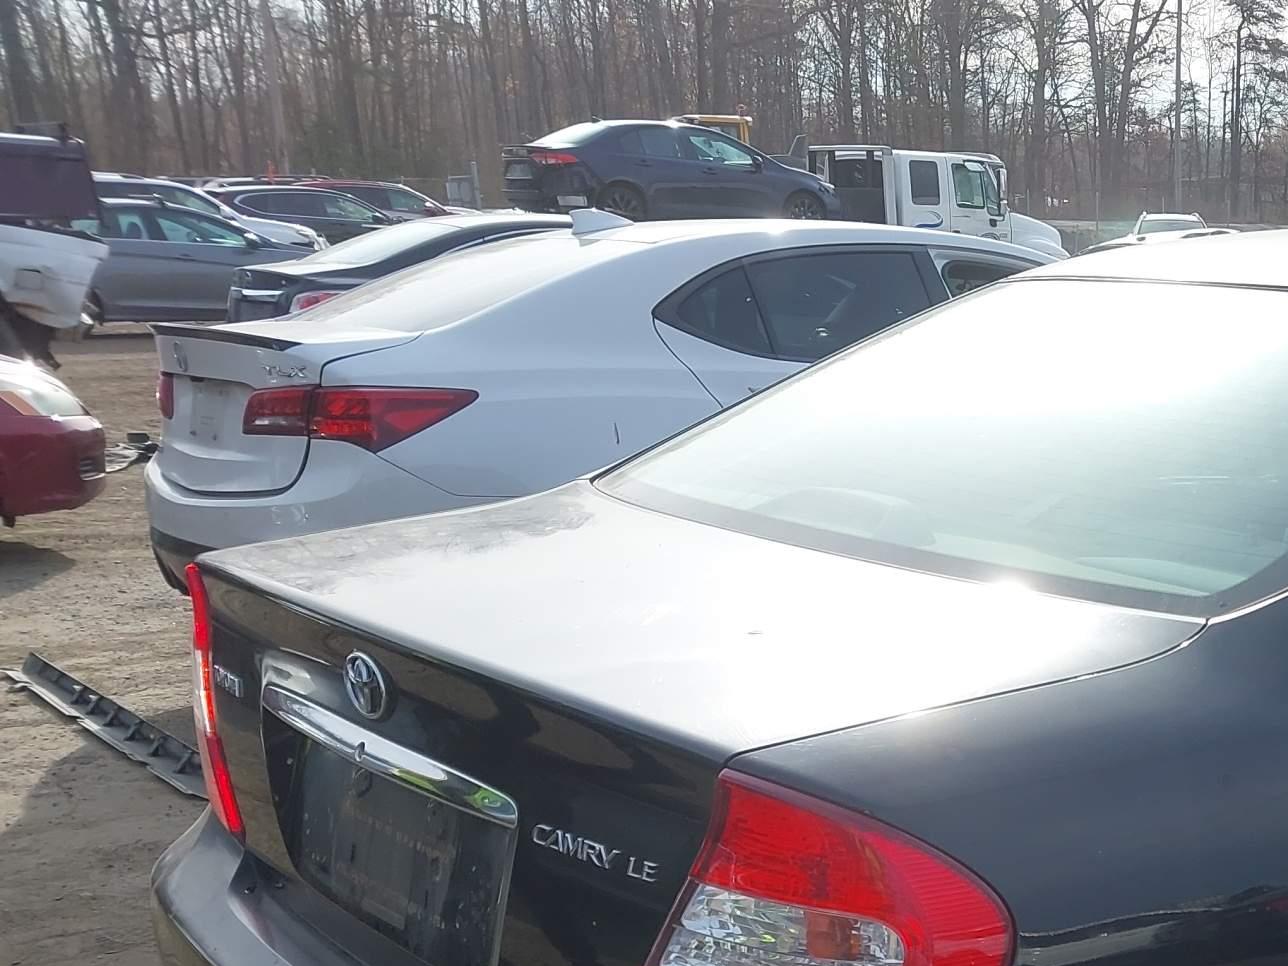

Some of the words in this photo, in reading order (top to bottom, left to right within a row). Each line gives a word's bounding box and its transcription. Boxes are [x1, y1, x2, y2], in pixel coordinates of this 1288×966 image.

[261, 364, 307, 378] TLX
[532, 824, 622, 870] CAMRY
[626, 856, 659, 882] LE
